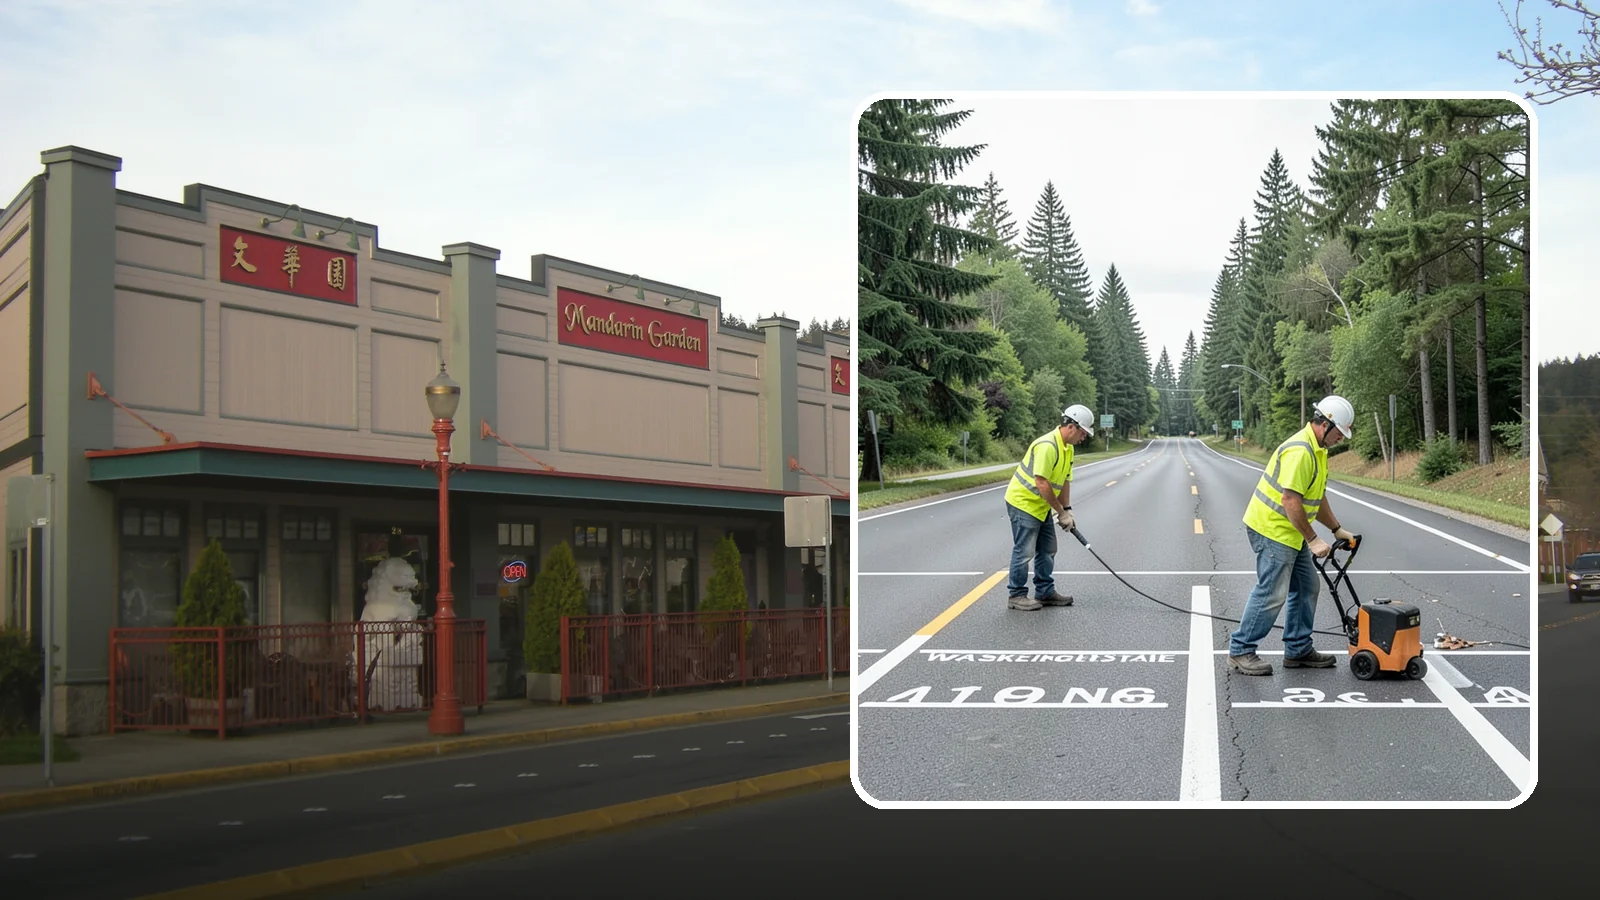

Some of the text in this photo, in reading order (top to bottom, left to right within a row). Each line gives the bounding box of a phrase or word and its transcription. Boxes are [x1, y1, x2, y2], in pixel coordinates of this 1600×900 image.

[231, 236, 346, 291] 文華園
[564, 302, 701, 352] Mandarin Garden
[503, 565, 527, 578] OPEN
